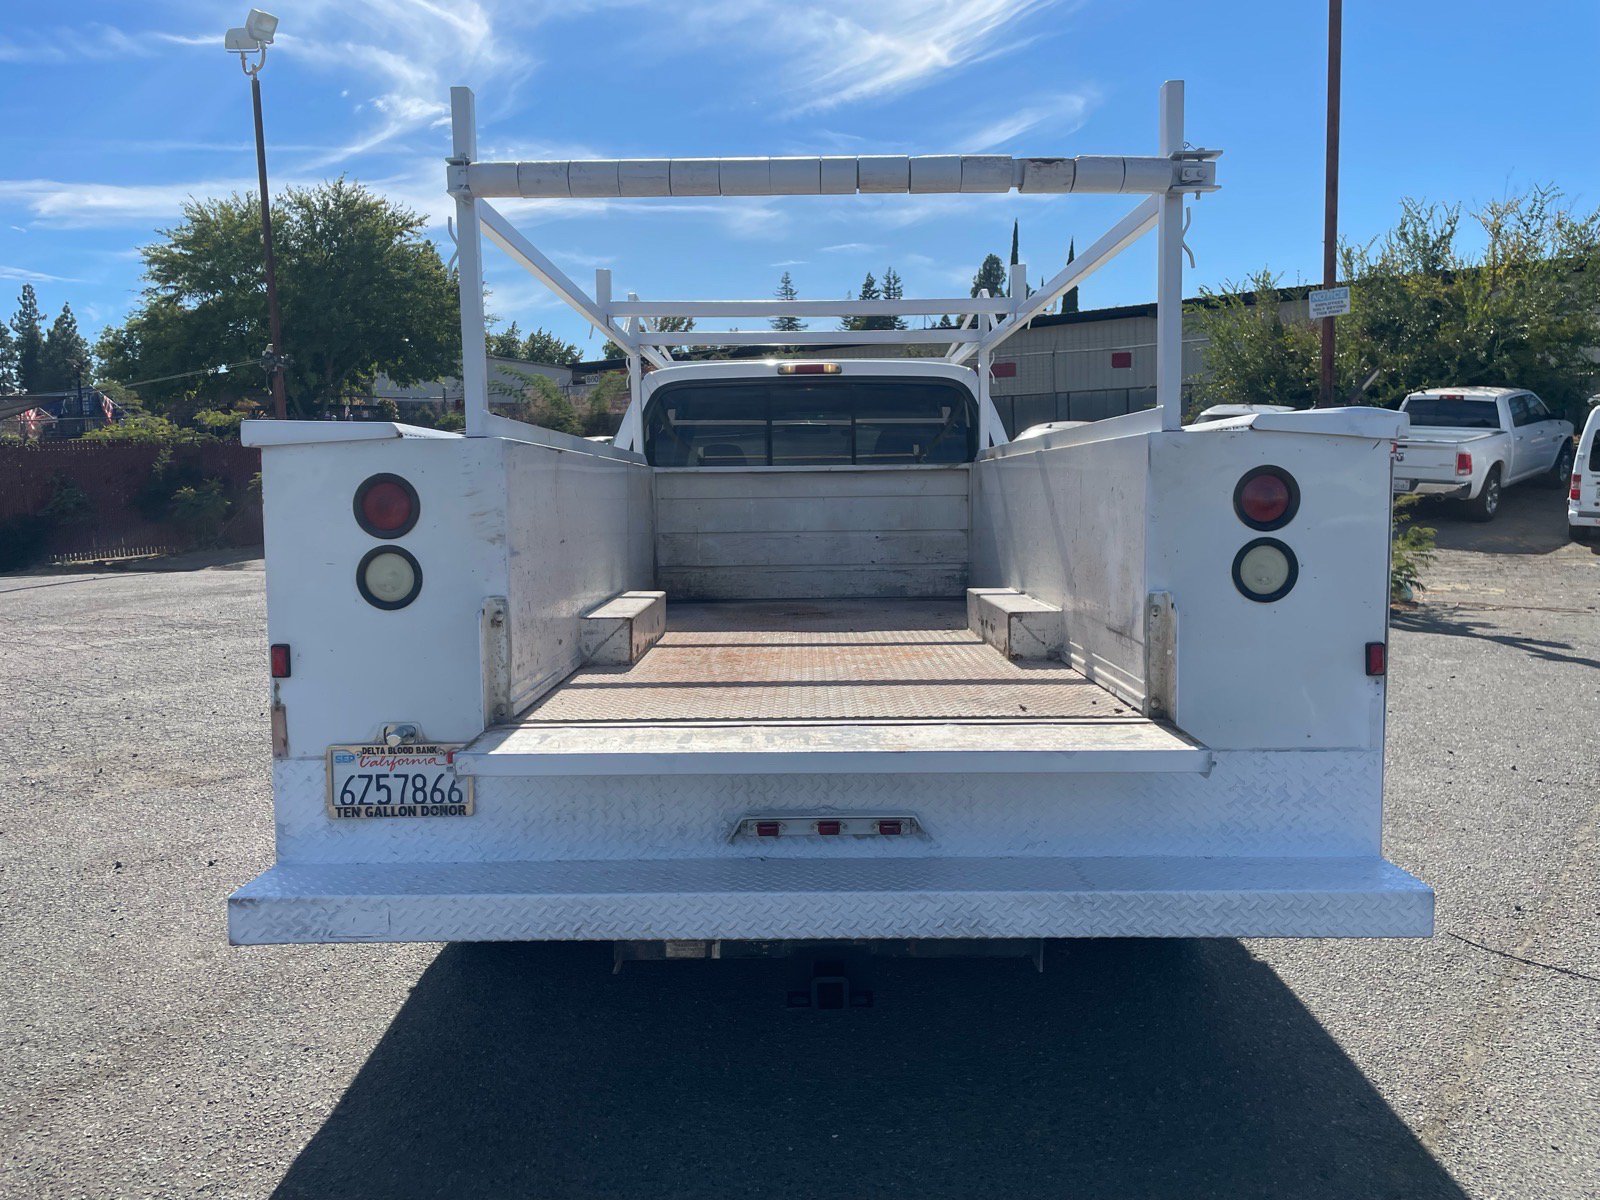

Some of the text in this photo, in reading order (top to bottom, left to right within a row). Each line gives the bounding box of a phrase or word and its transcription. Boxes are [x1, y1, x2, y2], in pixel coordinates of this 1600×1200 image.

[1312, 290, 1345, 301] NOTICE
[388, 746, 414, 754] BLOOD
[416, 746, 438, 754] BANK
[335, 754, 355, 763] SEP
[359, 755, 447, 772] California
[340, 773, 463, 805] 6Z57866
[336, 805, 467, 817] TEN GALLON DONOR
